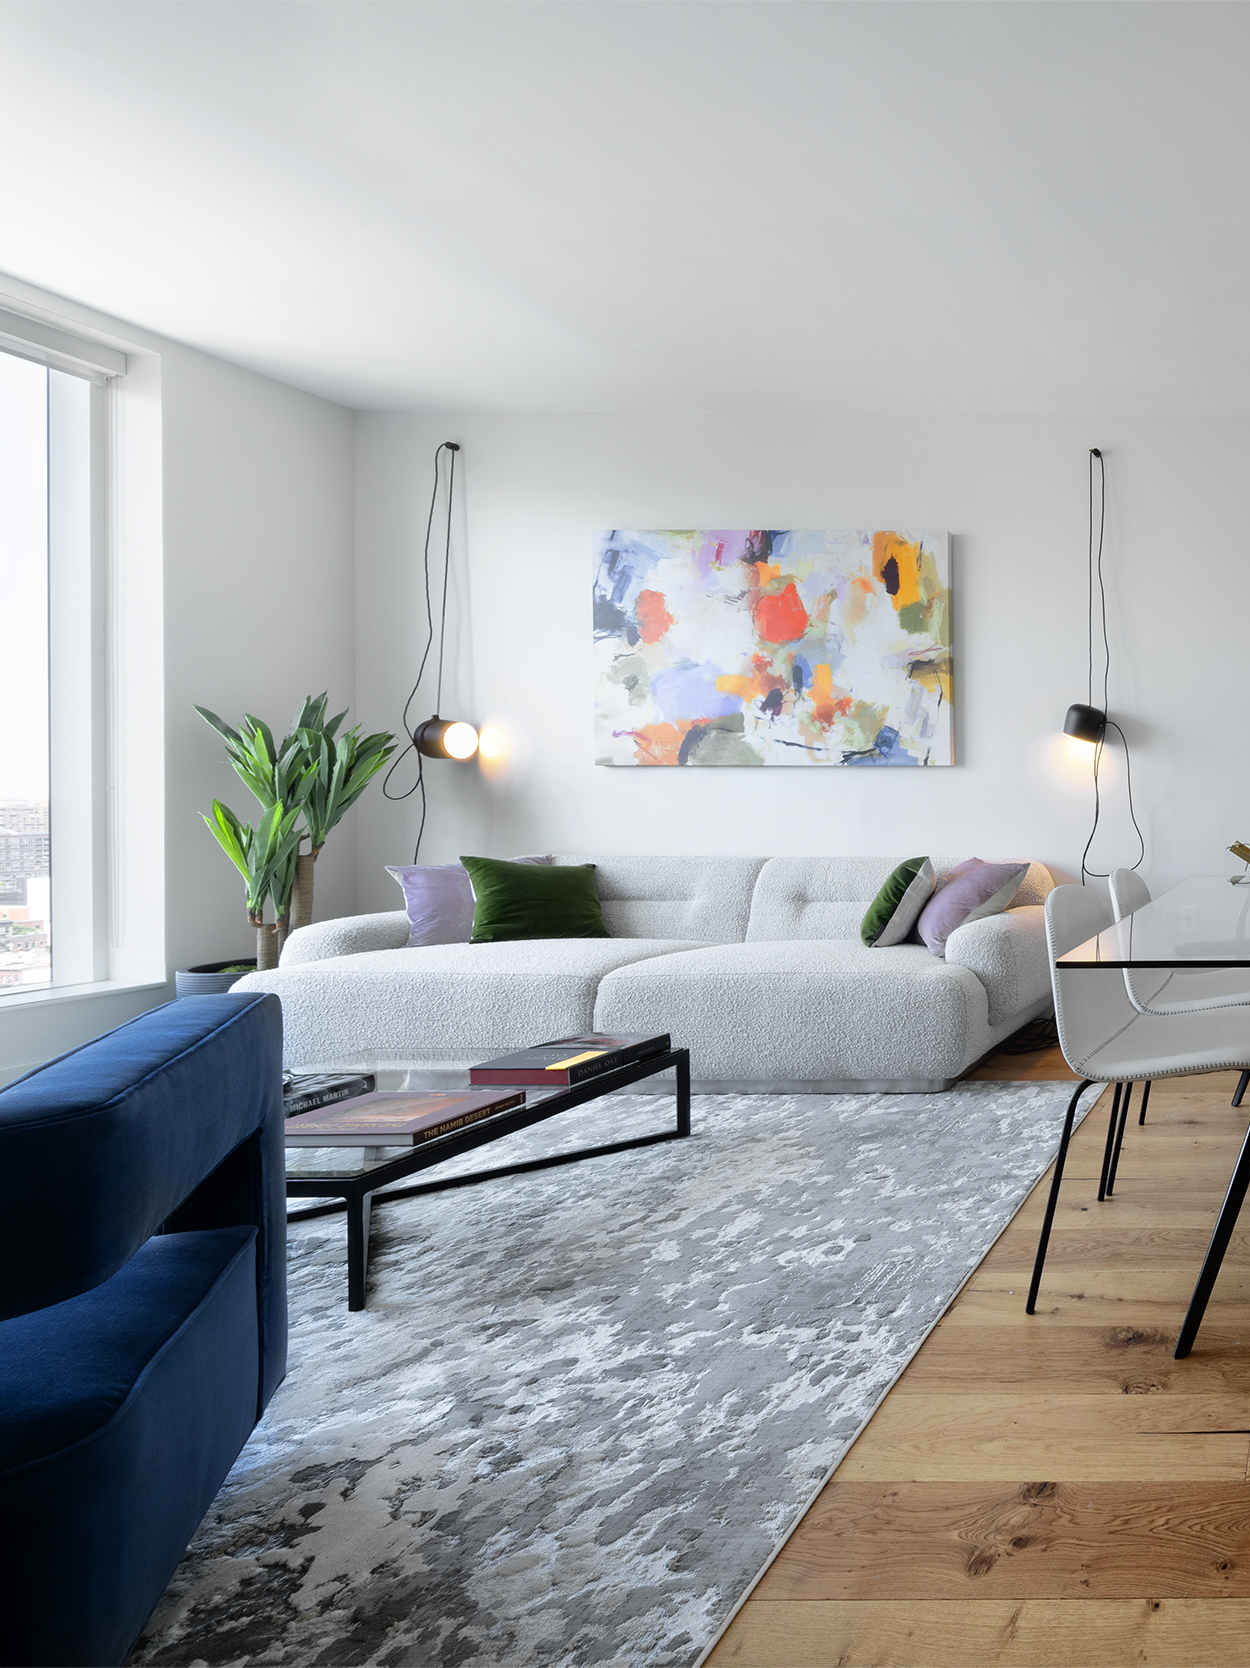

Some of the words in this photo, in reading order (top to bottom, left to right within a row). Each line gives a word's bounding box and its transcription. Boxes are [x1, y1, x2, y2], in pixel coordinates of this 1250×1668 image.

[577, 1063, 602, 1077] DANIEL
[604, 1057, 618, 1067] OST
[289, 1097, 321, 1113] MICHAEL
[323, 1088, 349, 1103] MARTIN
[423, 1127, 439, 1139] THE
[440, 1118, 464, 1133] NAMIB
[464, 1107, 491, 1123] DESERT
